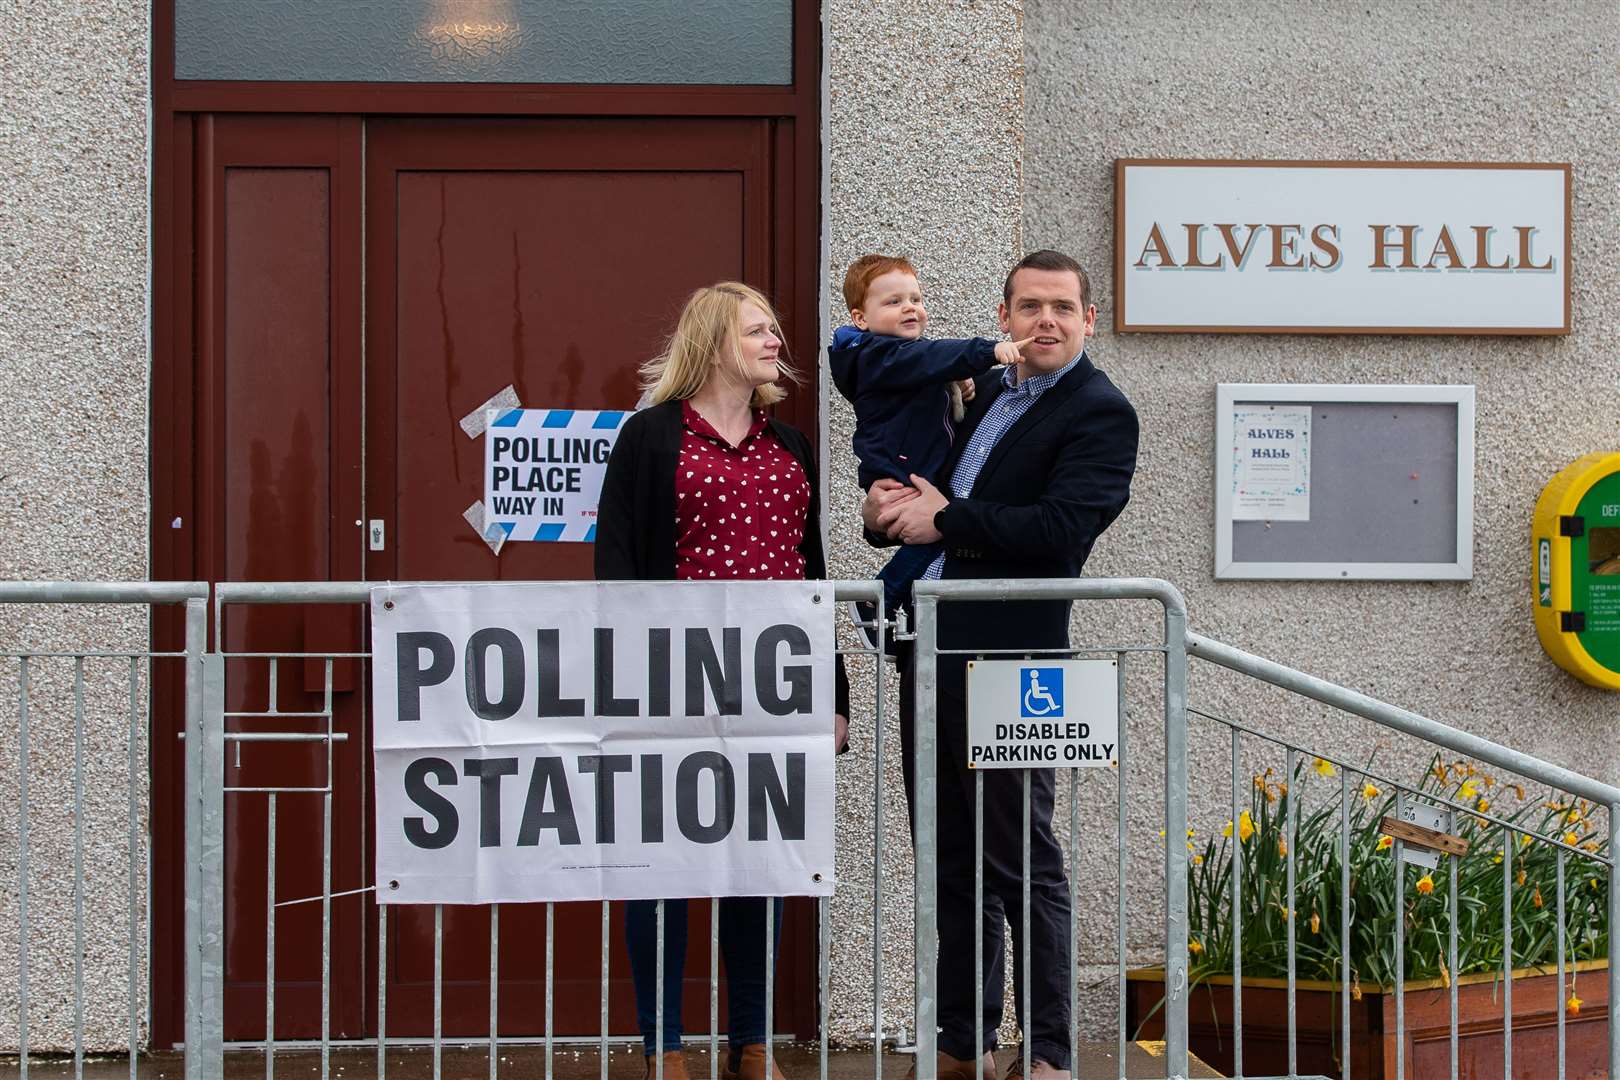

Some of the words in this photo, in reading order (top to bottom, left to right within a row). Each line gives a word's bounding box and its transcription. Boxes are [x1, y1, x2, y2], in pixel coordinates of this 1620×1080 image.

[1133, 221, 1344, 272] ALVES
[1368, 223, 1557, 274] HALL
[1247, 428, 1295, 440] ALVES
[493, 436, 611, 464] POLLING
[1251, 448, 1290, 459] HALL
[493, 466, 581, 493] PLACE
[493, 496, 537, 516] WAY
[543, 497, 563, 517] IN
[396, 623, 814, 722] POLLING
[995, 723, 1090, 740] DISABLED
[971, 744, 1057, 762] PARKING
[1063, 743, 1115, 761] ONLY
[402, 750, 807, 849] STATION
